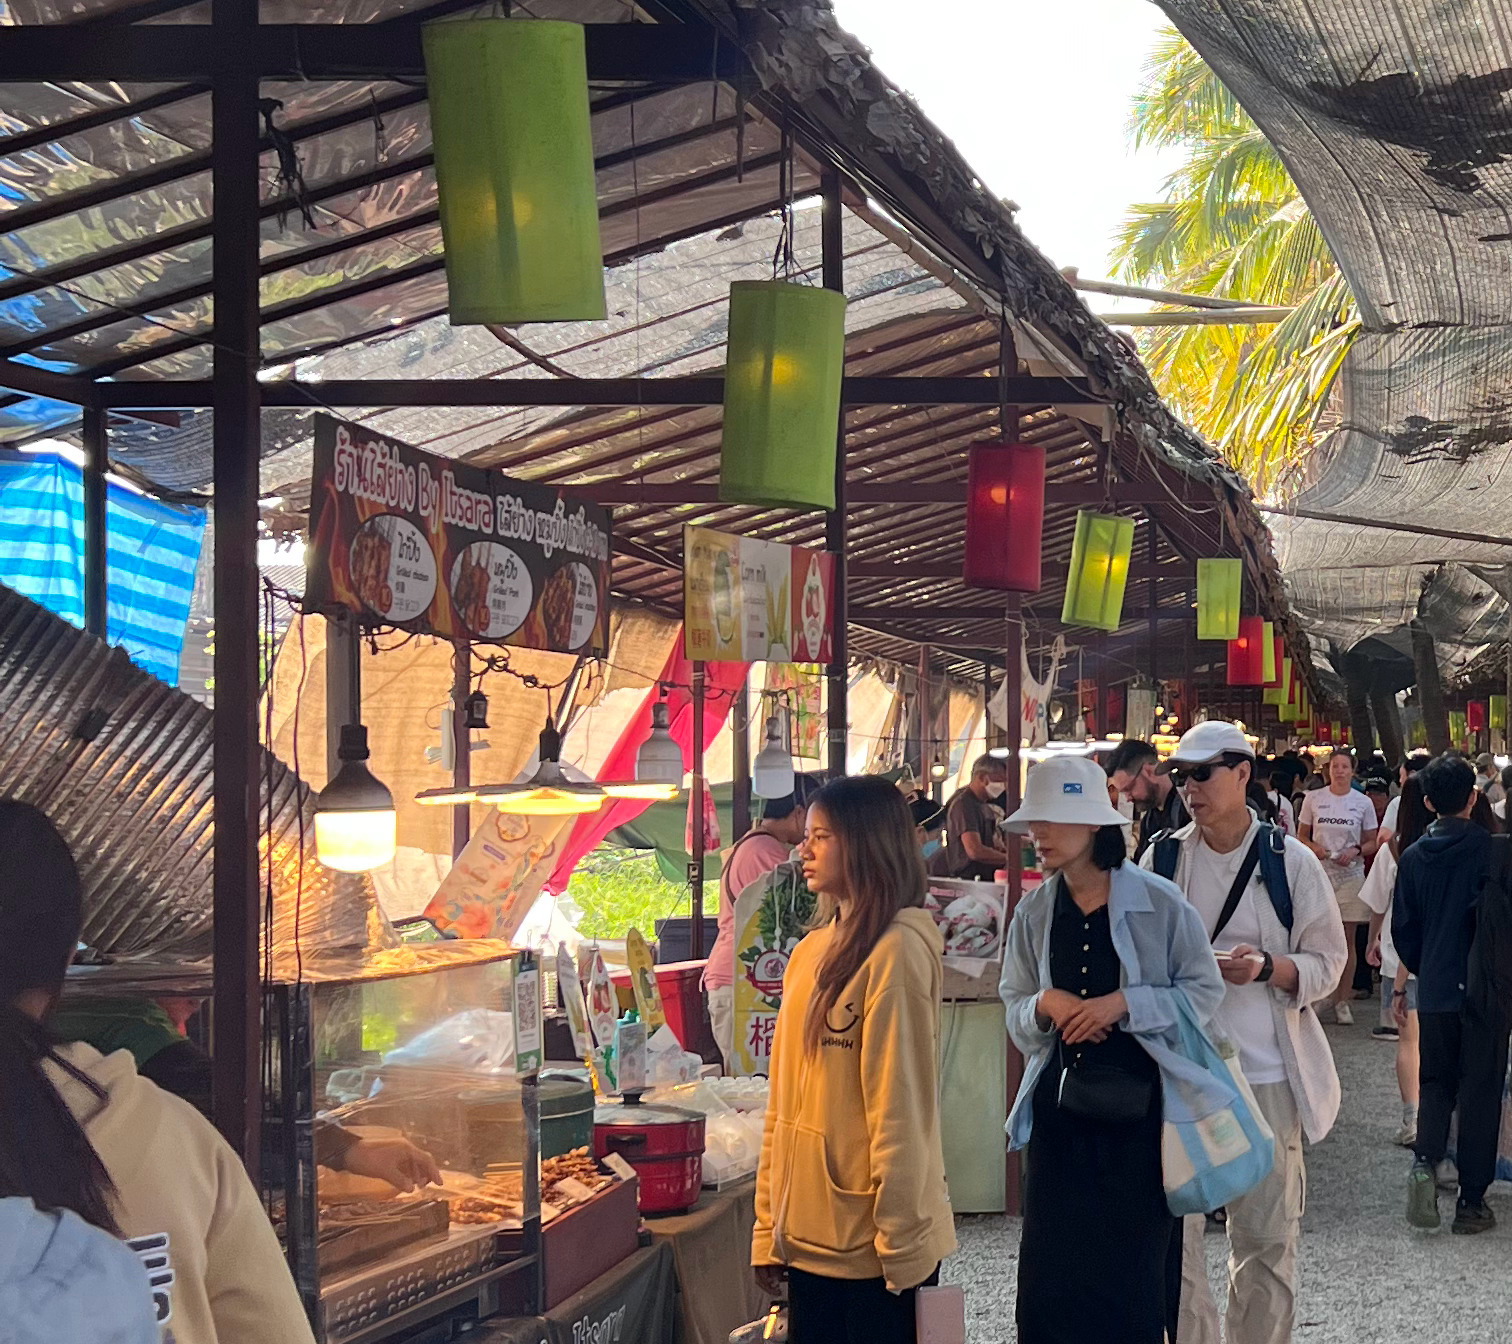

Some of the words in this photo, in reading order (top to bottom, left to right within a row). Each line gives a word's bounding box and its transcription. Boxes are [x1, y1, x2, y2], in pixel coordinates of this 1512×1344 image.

[418, 462, 440, 534] By
[441, 470, 494, 534] Itsara
[1318, 817, 1354, 826] BROOKS
